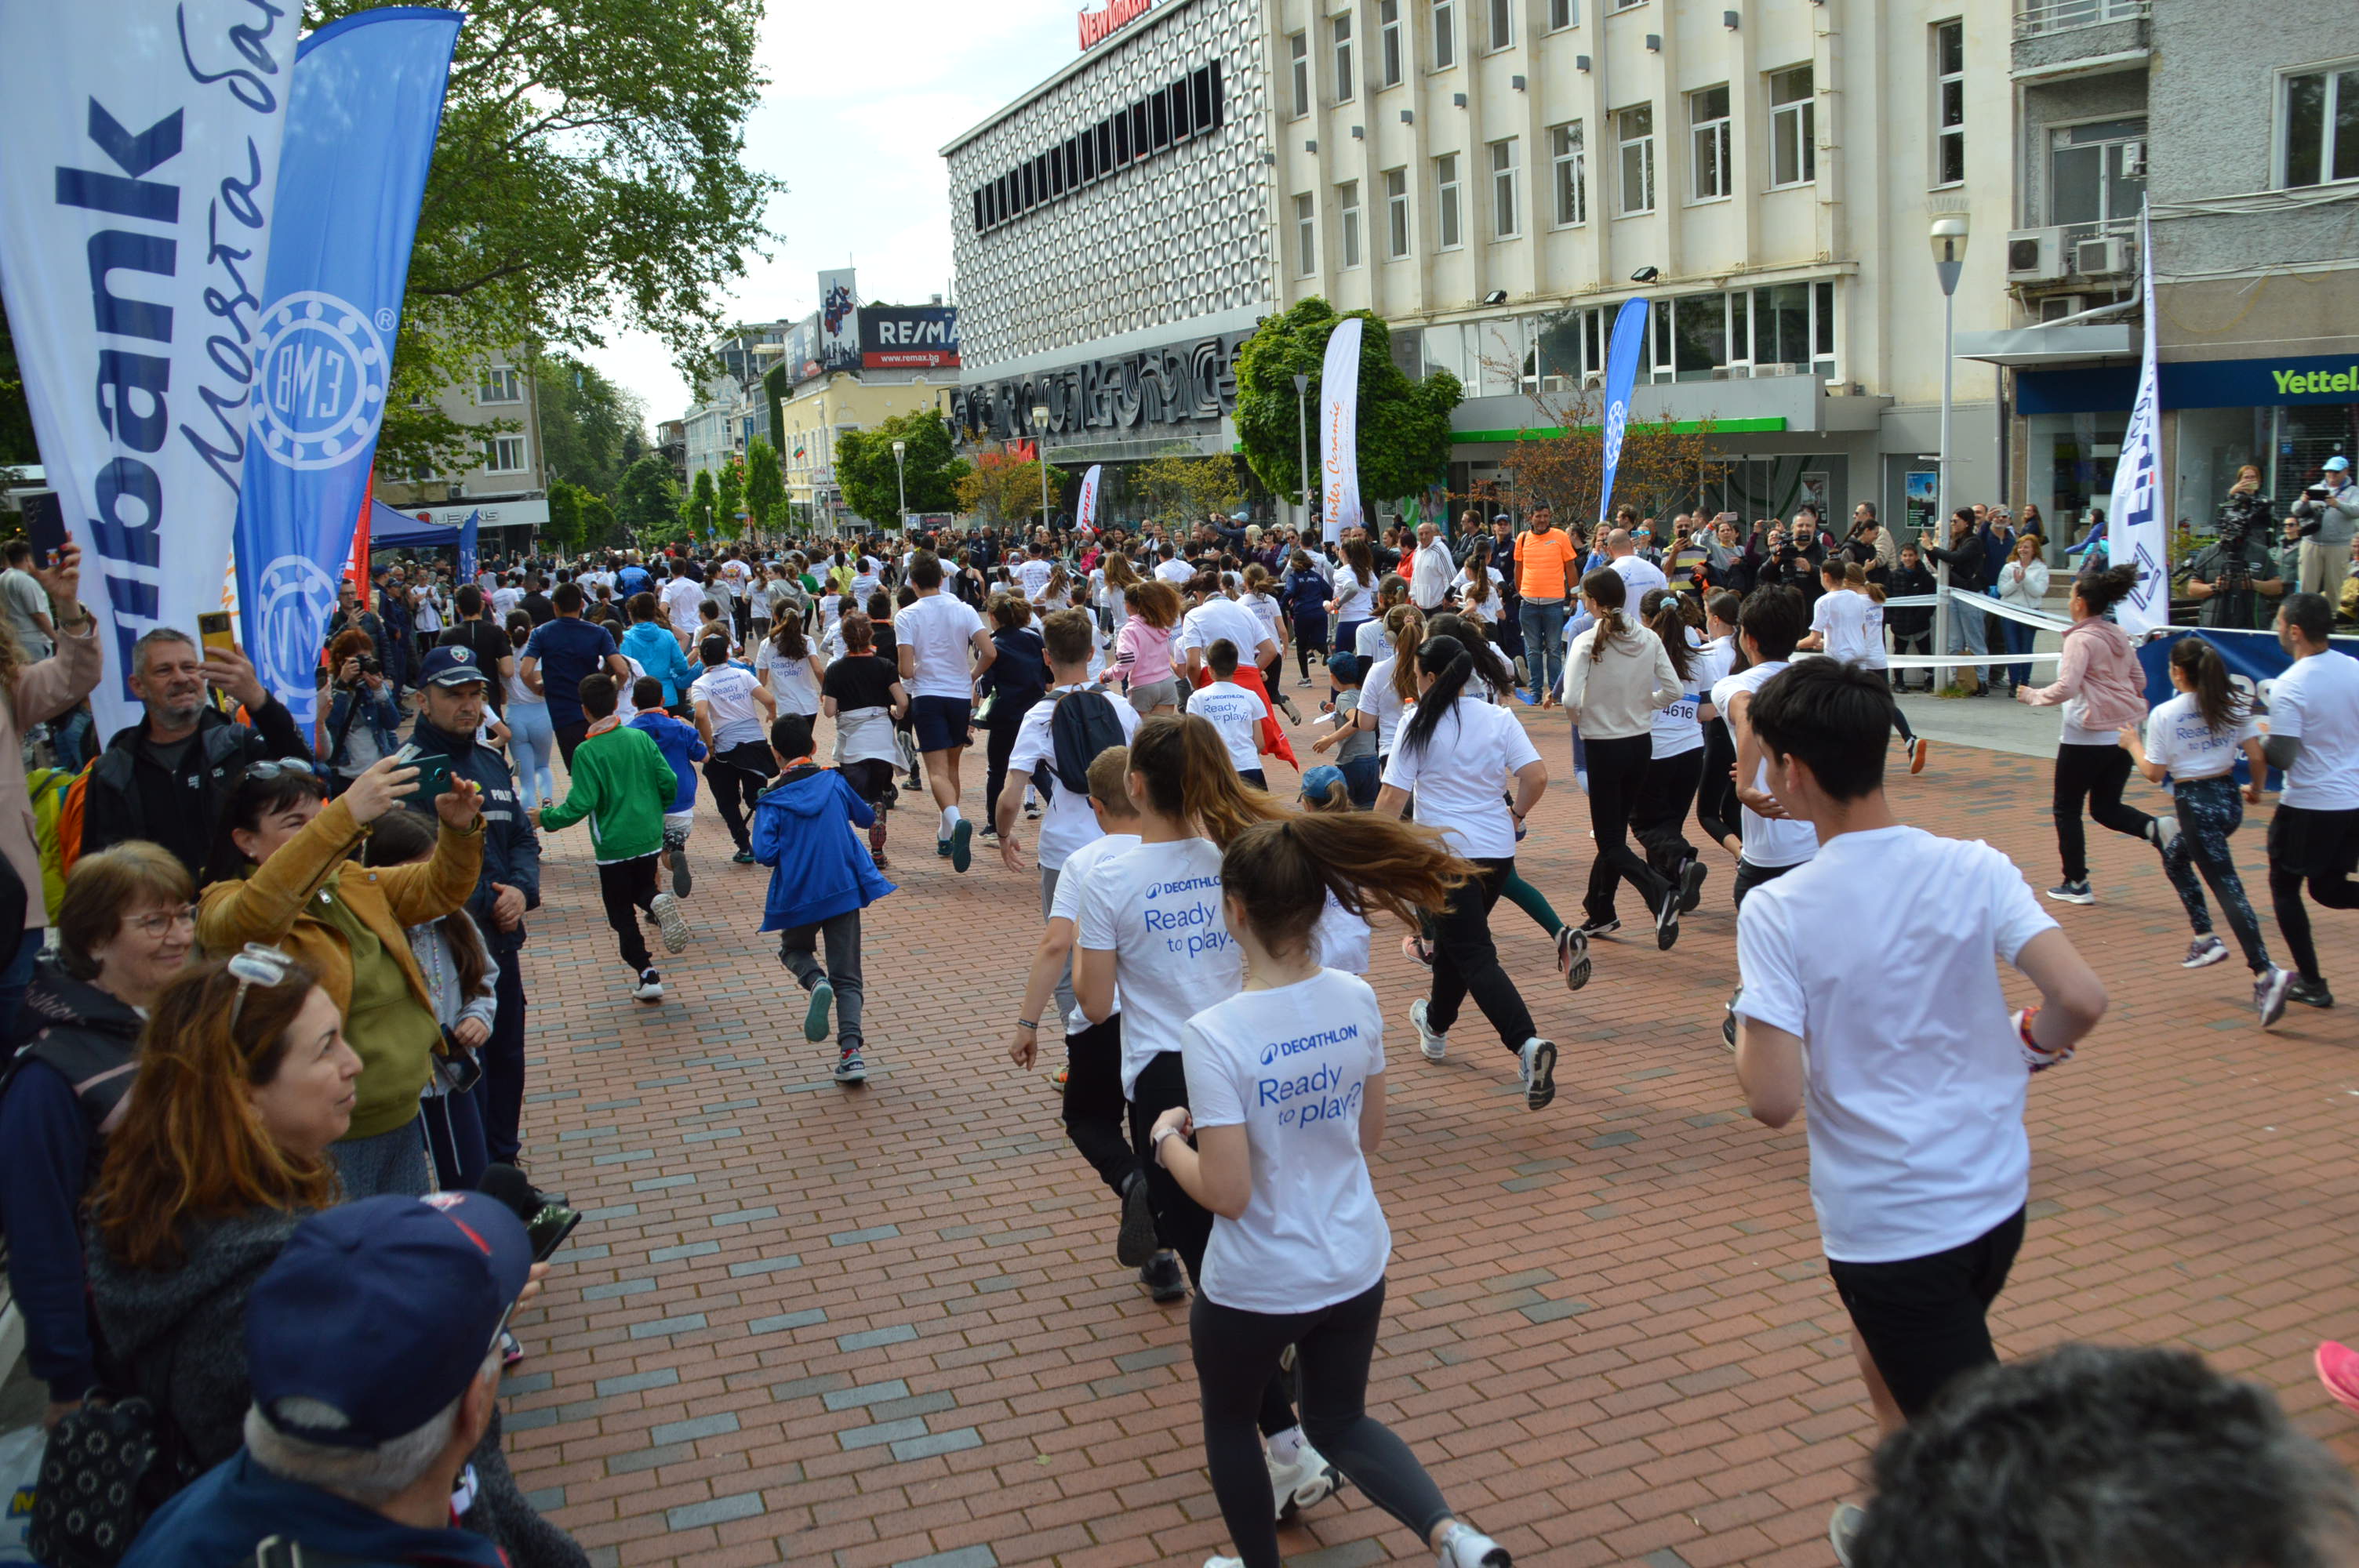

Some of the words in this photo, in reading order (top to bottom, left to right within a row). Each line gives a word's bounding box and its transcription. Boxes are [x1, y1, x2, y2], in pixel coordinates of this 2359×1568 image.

[878, 321, 961, 344] RE/MA
[881, 353, 940, 366] www.remax.bg
[55, 94, 184, 701] ibank
[1325, 400, 1342, 474] Ceramic
[1325, 481, 1341, 523] Inter
[771, 660, 796, 671] Ready
[783, 666, 803, 678] play?
[711, 683, 739, 697] Ready
[729, 688, 749, 704] play?
[1204, 702, 1238, 714] Ready
[1661, 704, 1694, 720] 4616
[1223, 711, 1249, 724] play?
[1164, 875, 1222, 895] DECATHLO
[1144, 901, 1216, 933] Ready
[1167, 938, 1183, 953] to
[1281, 1024, 1358, 1057] DECATHLON
[1259, 1062, 1343, 1107] Ready
[1278, 1109, 1296, 1126] to
[1299, 1082, 1362, 1129] play?
